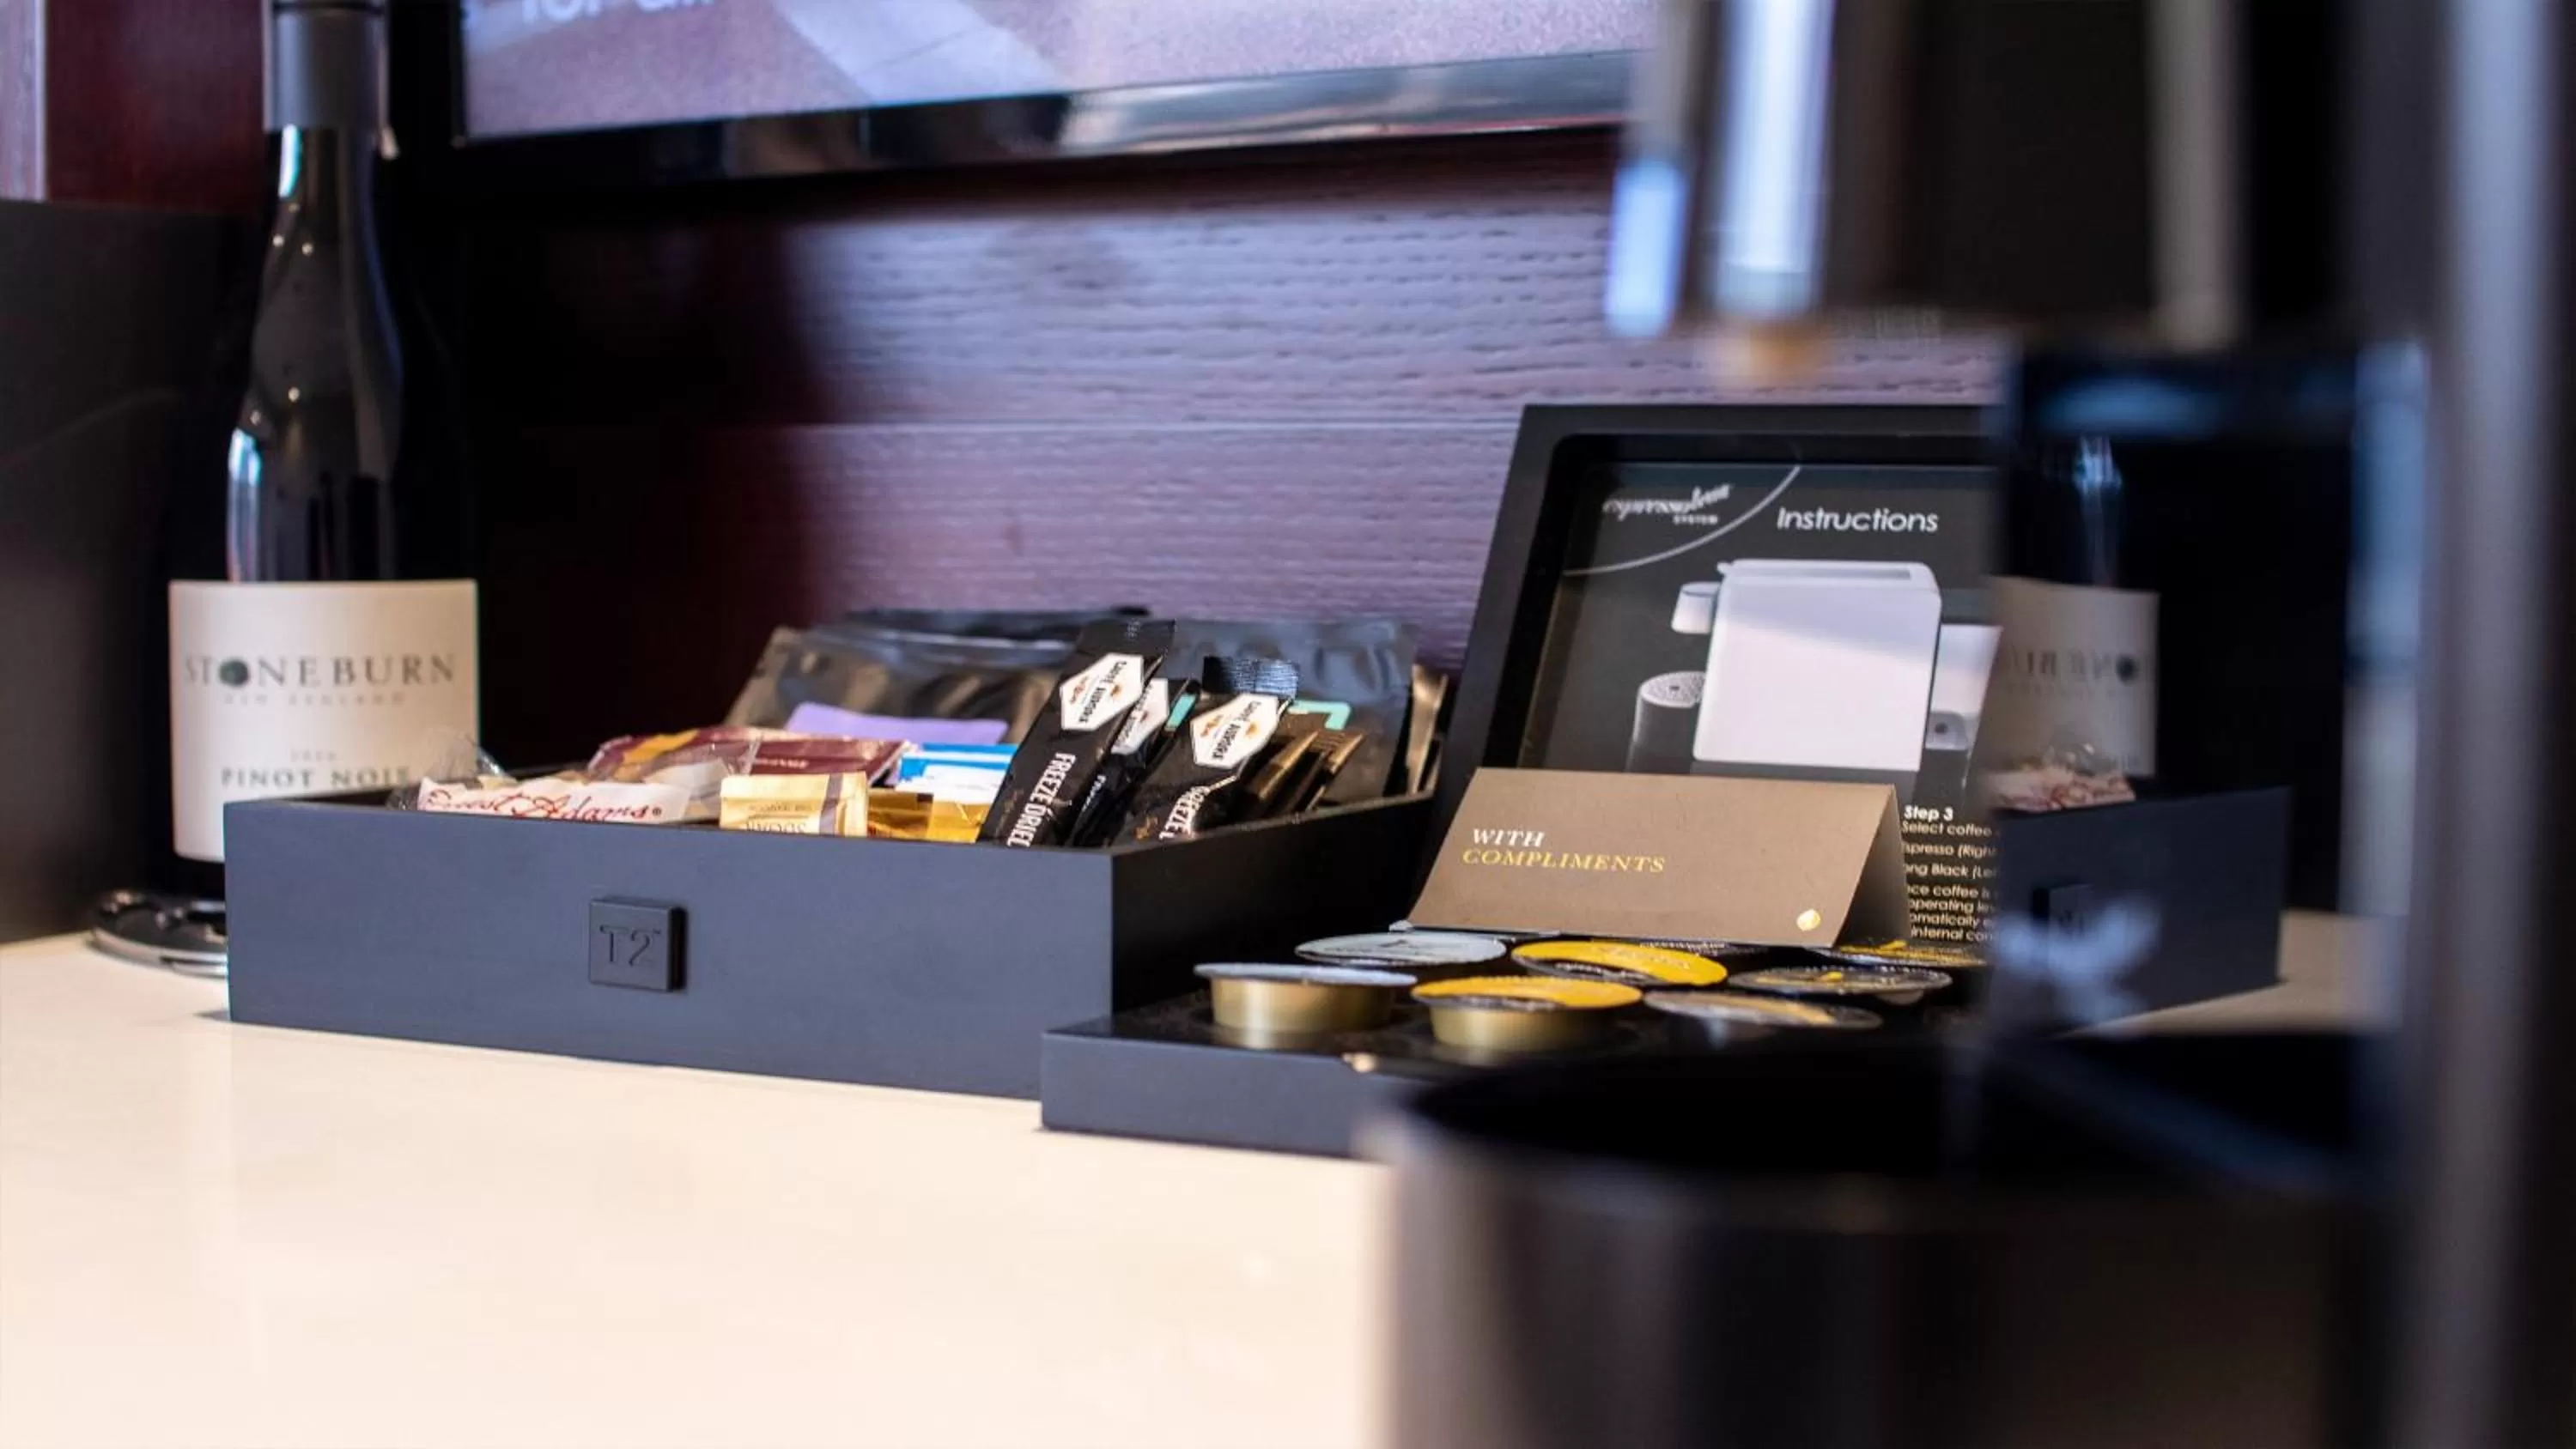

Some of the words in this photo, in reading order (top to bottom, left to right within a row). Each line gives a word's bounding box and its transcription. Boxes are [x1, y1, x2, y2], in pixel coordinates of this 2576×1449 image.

[1777, 506, 1938, 533] Instructions
[184, 654, 456, 688] STONEBURN
[220, 767, 314, 789] PINOT
[1029, 752, 1077, 805] FREEZE
[1904, 804, 1940, 822] Step
[1943, 806, 1954, 822] 3
[1473, 828, 1545, 848] WITH
[1902, 821, 1944, 834] Select
[1947, 822, 1992, 837] coffee
[1462, 847, 1666, 873] COMPLIMENTS
[1902, 844, 1955, 858] spresso
[1931, 863, 1969, 876] Black
[1933, 883, 1979, 898] coffee
[598, 925, 661, 967] T2
